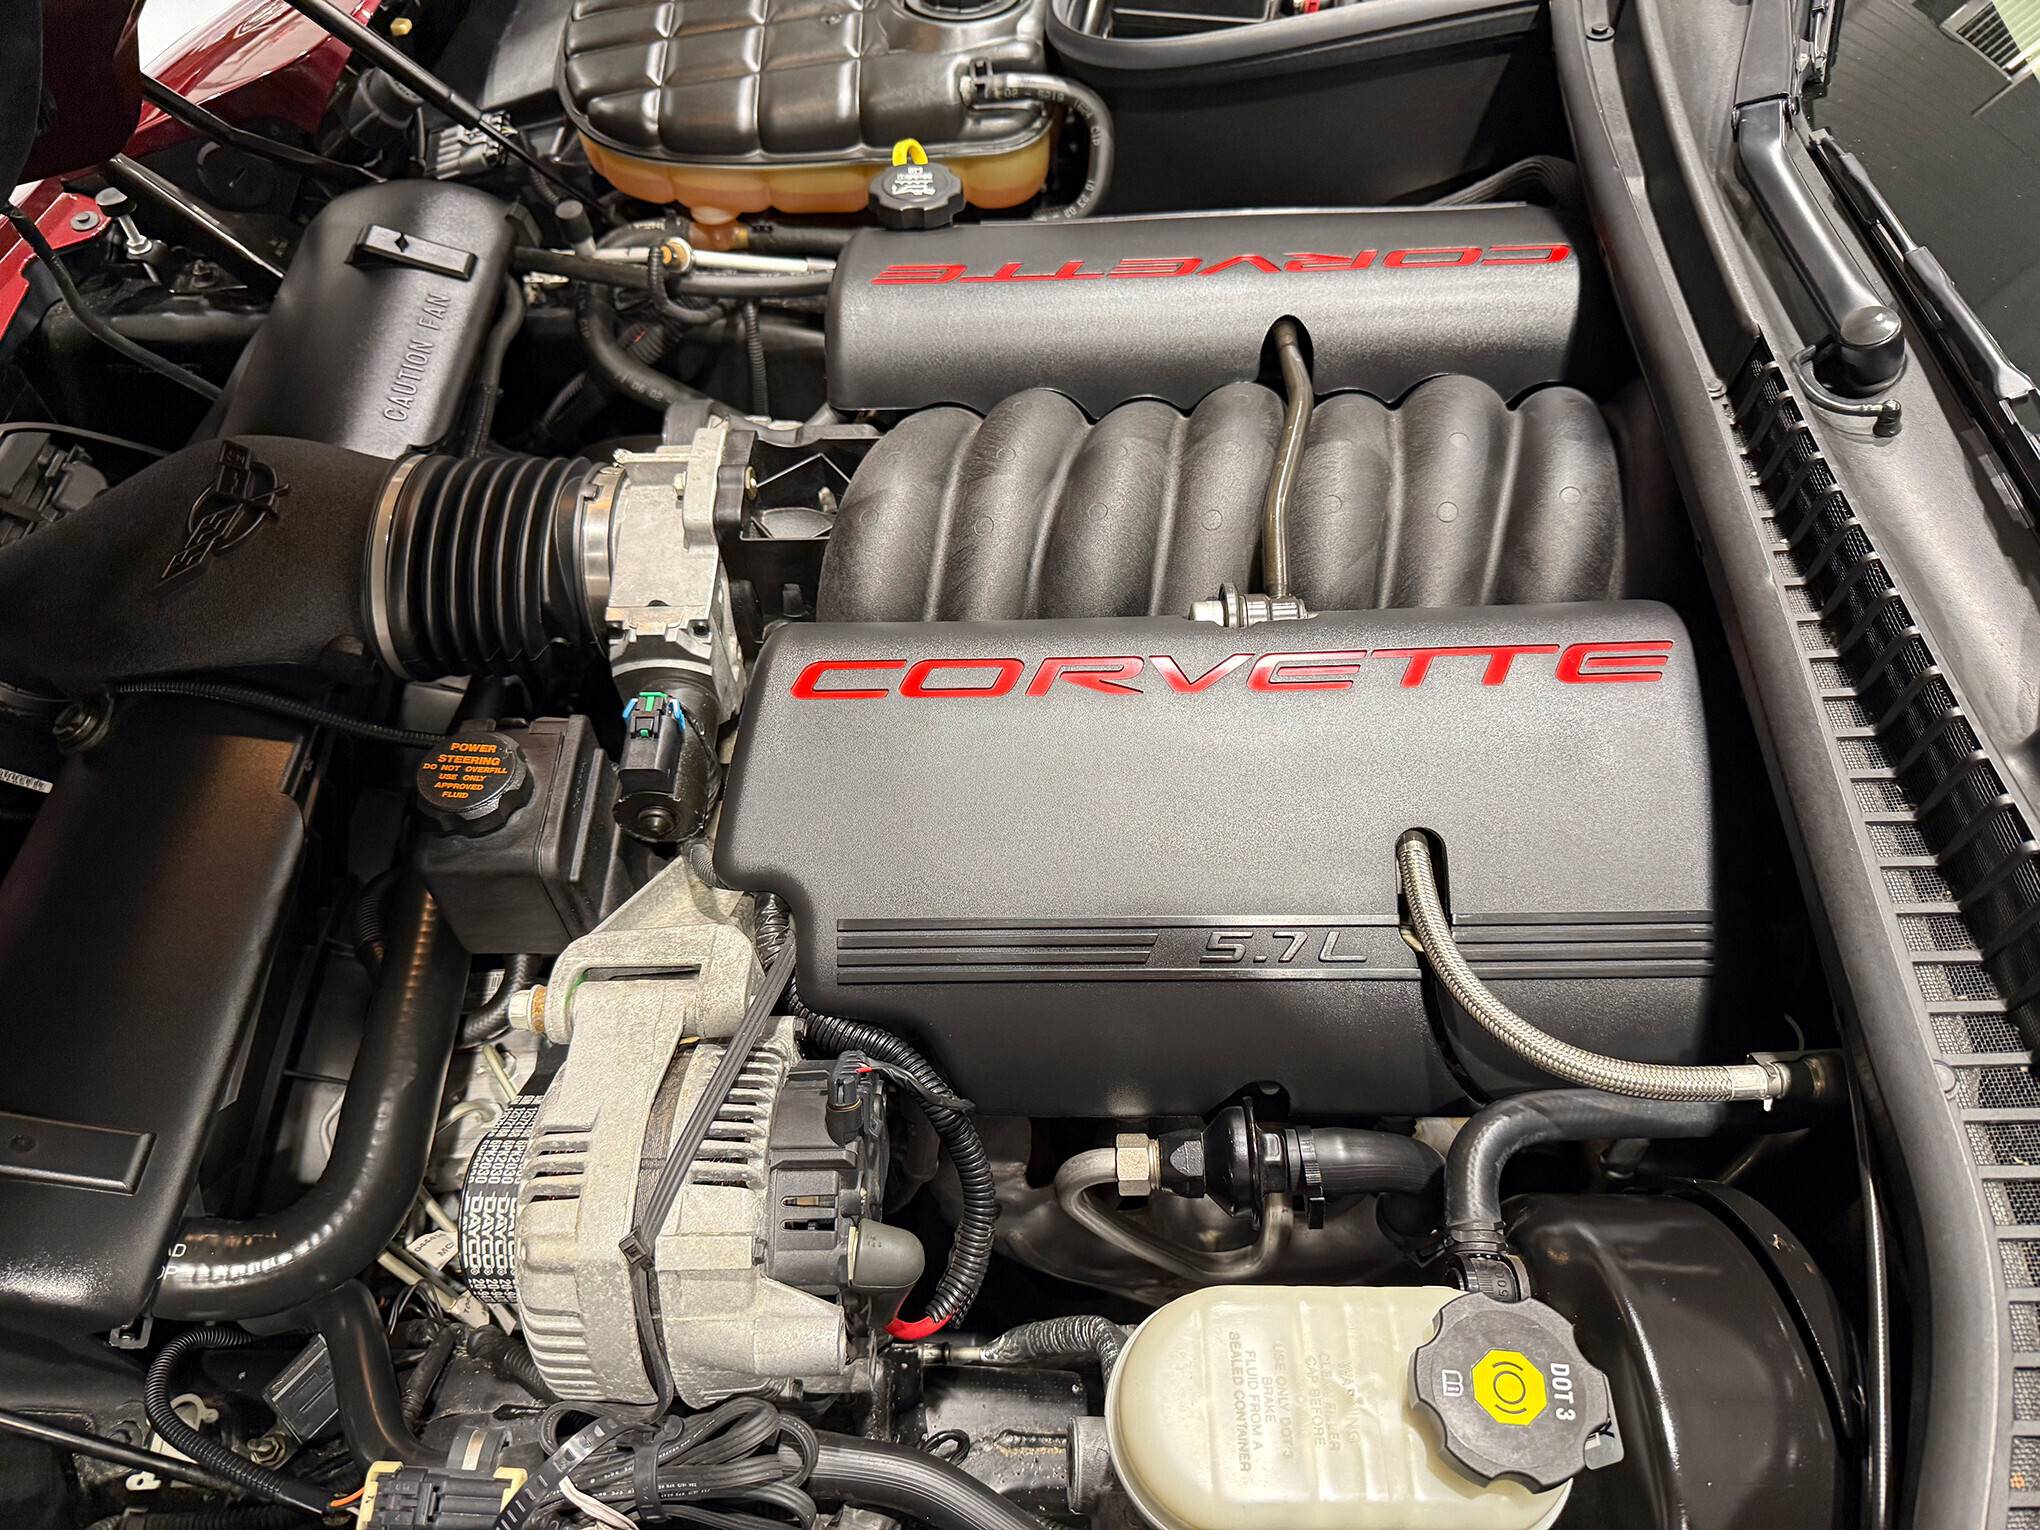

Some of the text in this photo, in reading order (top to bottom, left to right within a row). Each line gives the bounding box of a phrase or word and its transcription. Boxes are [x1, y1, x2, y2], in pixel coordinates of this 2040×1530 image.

[870, 242, 1573, 285] CORVETTE
[383, 293, 451, 421] CAUTION FAN
[789, 640, 1674, 699] CORVETTE
[437, 754, 501, 766] STEERING
[440, 764, 461, 772] NOT
[465, 766, 508, 774] OVERFILL
[450, 742, 498, 754] POWER
[434, 781, 485, 791] APPROVED
[438, 773, 487, 782] USE ONLY
[441, 790, 470, 799] FLUID
[475, 1139, 502, 1185] 6PK2030
[488, 1139, 516, 1185] 6PK2030
[502, 1139, 529, 1185] 6PK2030
[468, 1193, 484, 1269] DAYCO
[481, 1193, 497, 1269] DAYCO
[495, 1193, 511, 1269] DAYCO
[1272, 1343, 1287, 1371] USE
[1228, 1331, 1251, 1472] SEALED CONTAINER
[1244, 1350, 1264, 1450] FLUID FROM A
[1261, 1376, 1278, 1424] BRAKE
[1275, 1375, 1291, 1412] ONLY
[1305, 1356, 1326, 1446] CAP BEFORE
[1550, 1362, 1577, 1421] DOT 3
[1279, 1417, 1293, 1446] DOT
